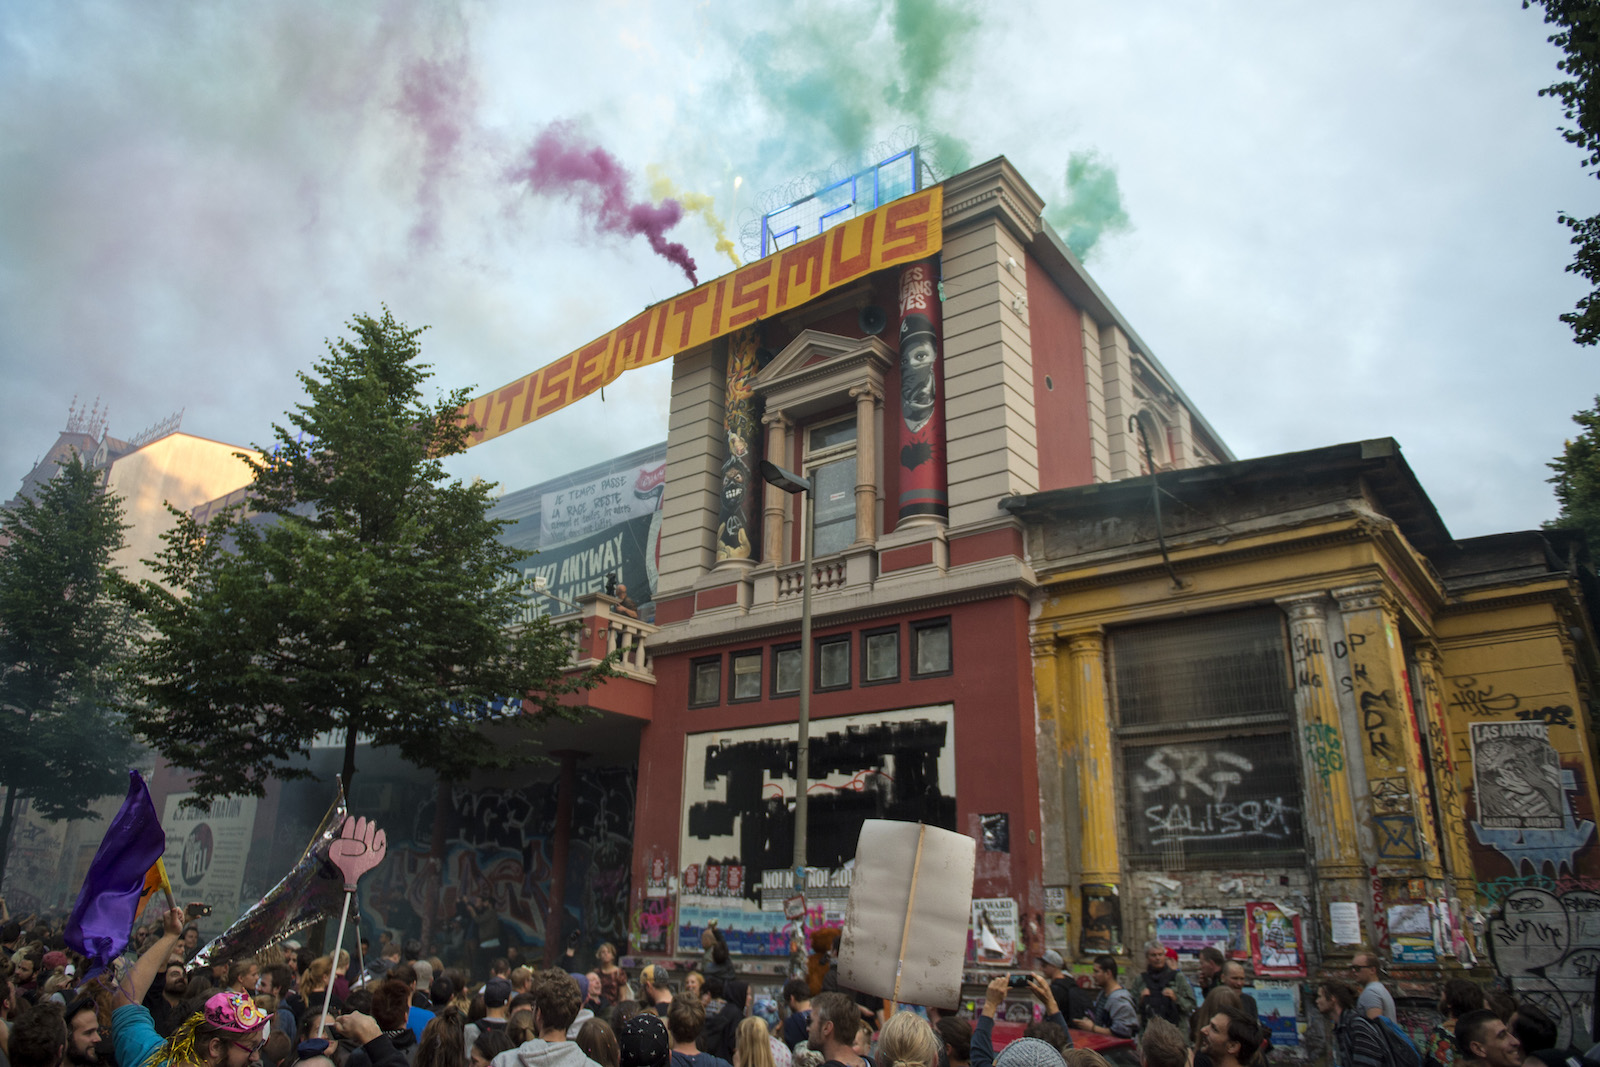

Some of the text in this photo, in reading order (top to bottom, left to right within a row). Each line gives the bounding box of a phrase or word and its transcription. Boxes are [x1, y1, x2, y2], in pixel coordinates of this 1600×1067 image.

[568, 484, 596, 500] TEMPS
[601, 476, 627, 491] PASSE
[552, 492, 622, 519] LA RAGE RESTE
[559, 532, 623, 585] ANYWAY
[1474, 725, 1499, 743] LAS
[763, 871, 783, 889] NO!
[808, 869, 829, 888] NO!
[974, 901, 1013, 910] REWARD
